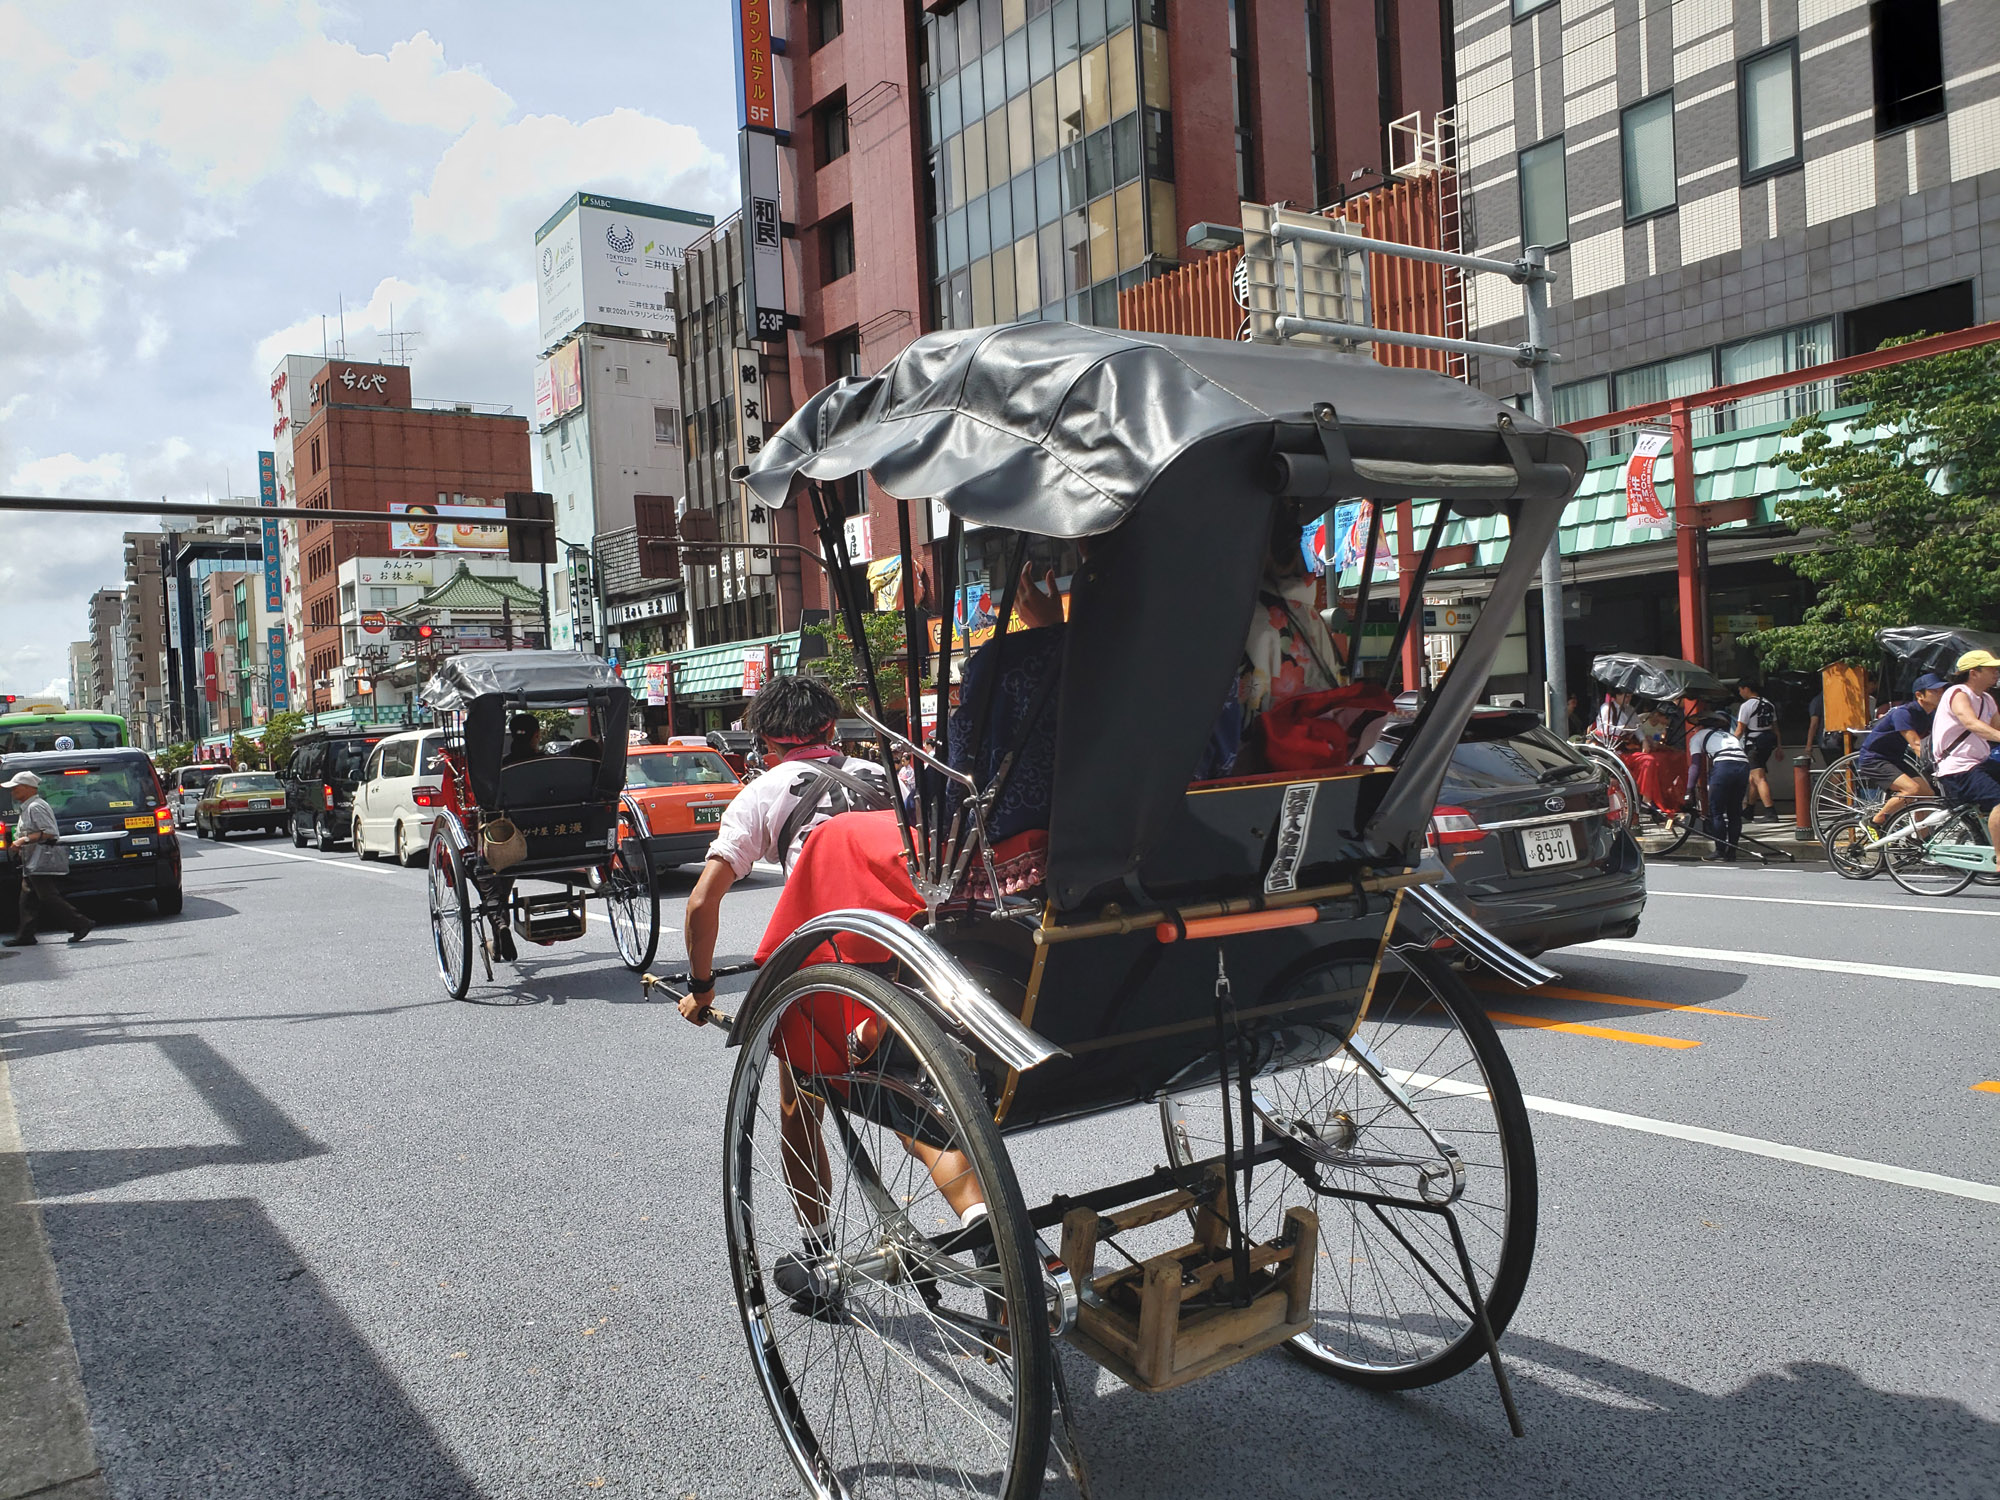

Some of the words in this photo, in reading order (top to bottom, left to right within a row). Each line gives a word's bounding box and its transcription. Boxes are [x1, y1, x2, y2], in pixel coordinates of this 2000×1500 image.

[750, 105, 769, 121] 5F
[590, 197, 611, 208] SMBC
[755, 200, 776, 245] 和民
[659, 244, 687, 258] SMB
[339, 367, 387, 394] ちんや
[384, 561, 422, 569] あんみつ
[1535, 831, 1548, 841] 足立
[1549, 828, 1563, 839] 330
[74, 849, 106, 861] 32-32
[1536, 840, 1572, 862] 89-01
